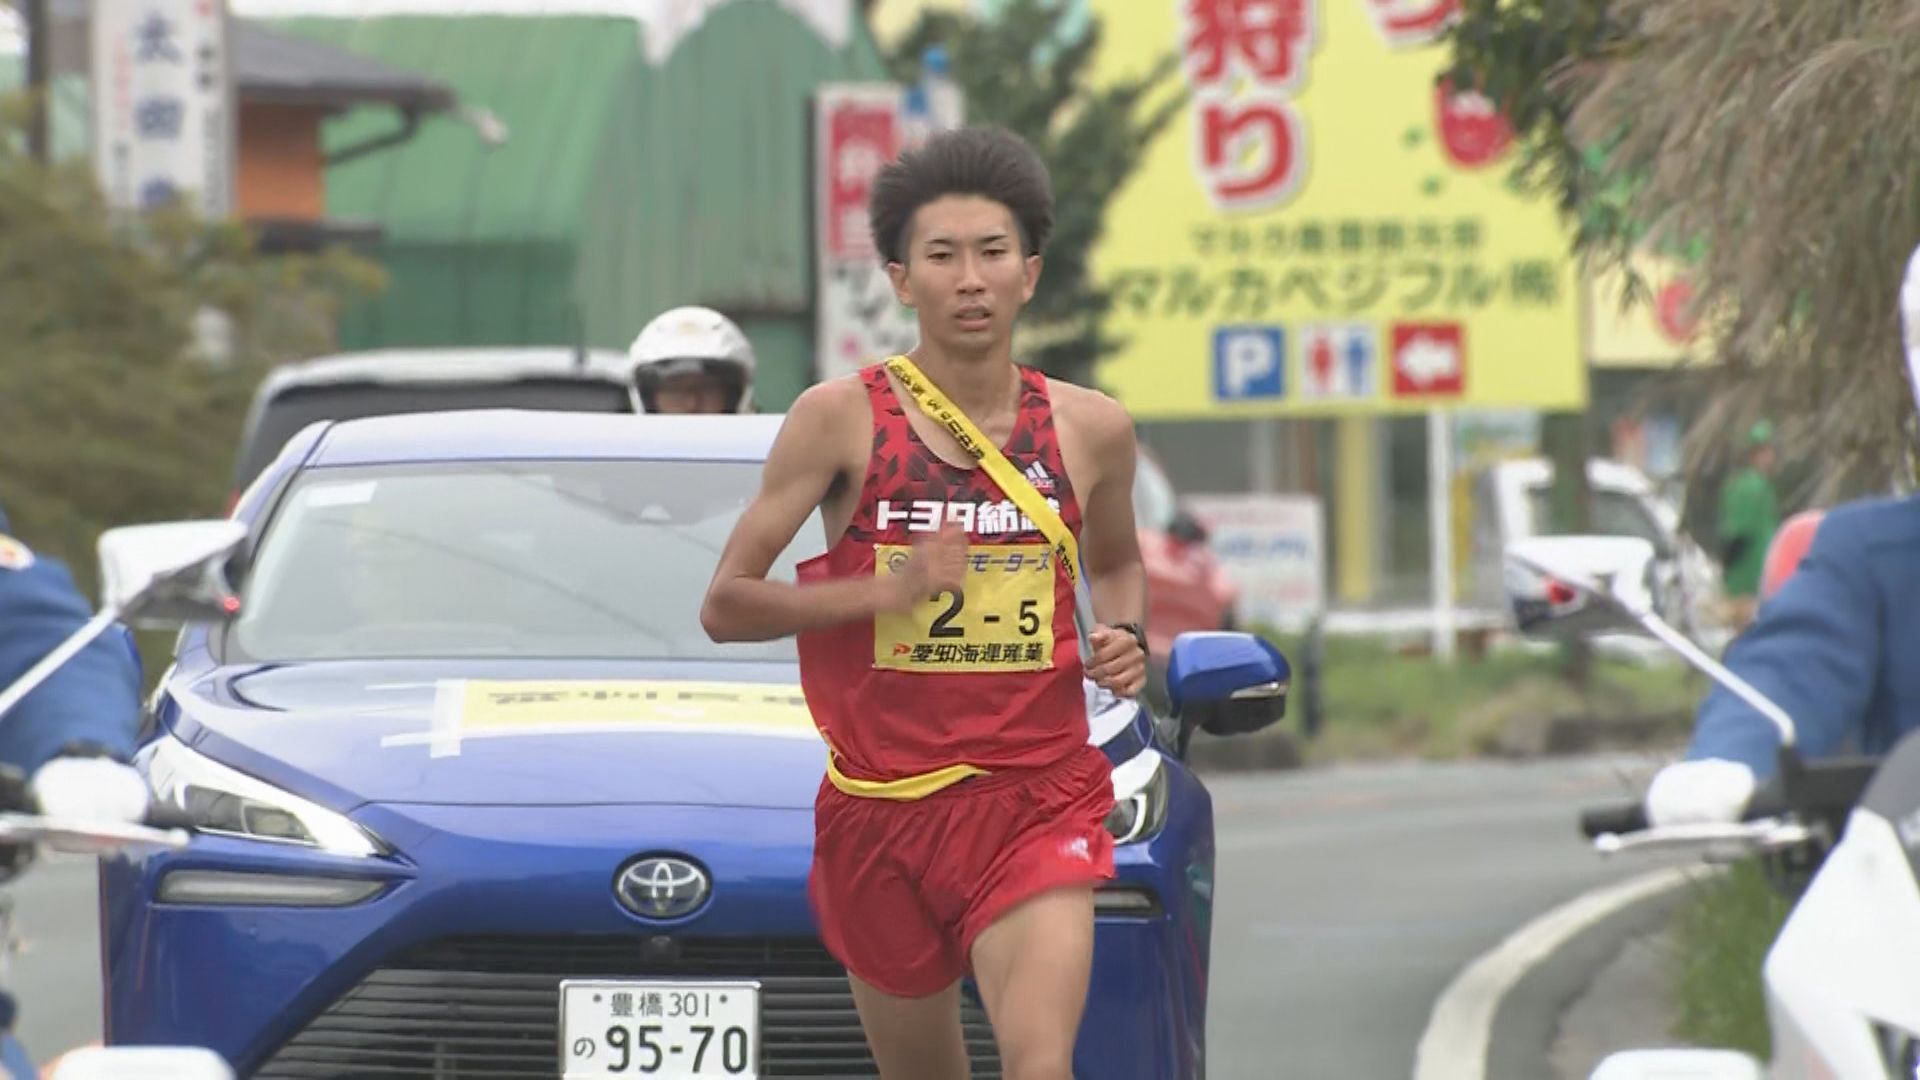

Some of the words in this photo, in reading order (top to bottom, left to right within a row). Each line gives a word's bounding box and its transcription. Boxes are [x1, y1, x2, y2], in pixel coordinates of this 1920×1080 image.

[910, 642, 1044, 663] 愛知海運産業
[573, 1036, 596, 1059] の
[605, 1024, 748, 1074] 95-70
